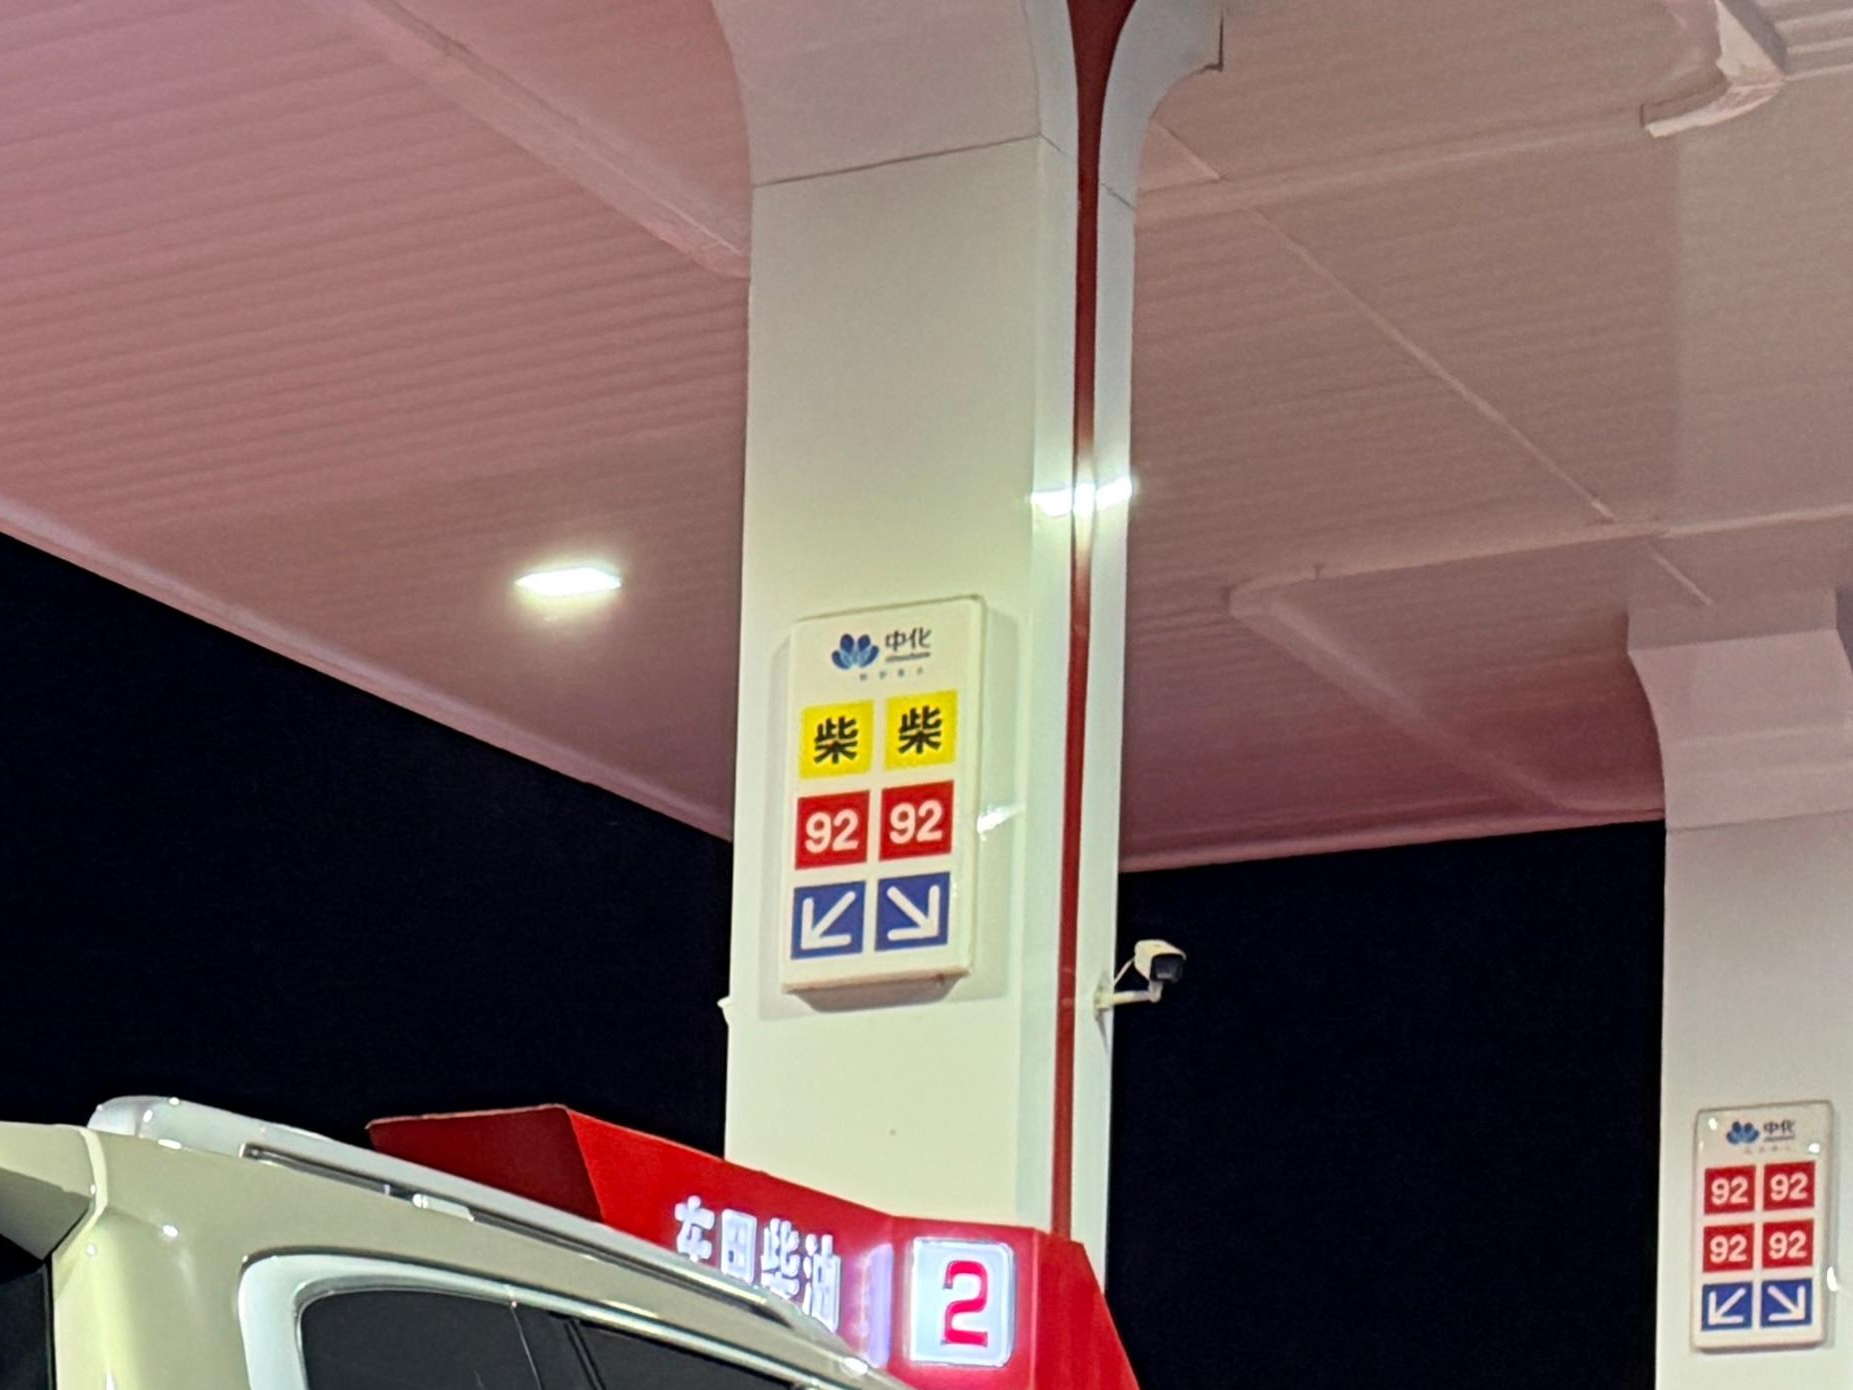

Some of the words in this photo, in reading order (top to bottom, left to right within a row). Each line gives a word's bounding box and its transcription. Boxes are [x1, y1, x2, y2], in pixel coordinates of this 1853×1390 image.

[883, 626, 932, 653] 中化
[812, 715, 859, 765] 柴
[897, 704, 943, 755] 柴
[804, 808, 860, 854] 92
[888, 799, 944, 845] 92
[1711, 1175, 1749, 1205] 92
[1769, 1171, 1808, 1200] 92
[1709, 1235, 1748, 1263] 92
[1767, 1231, 1807, 1259] 92
[941, 1259, 989, 1347] 2
